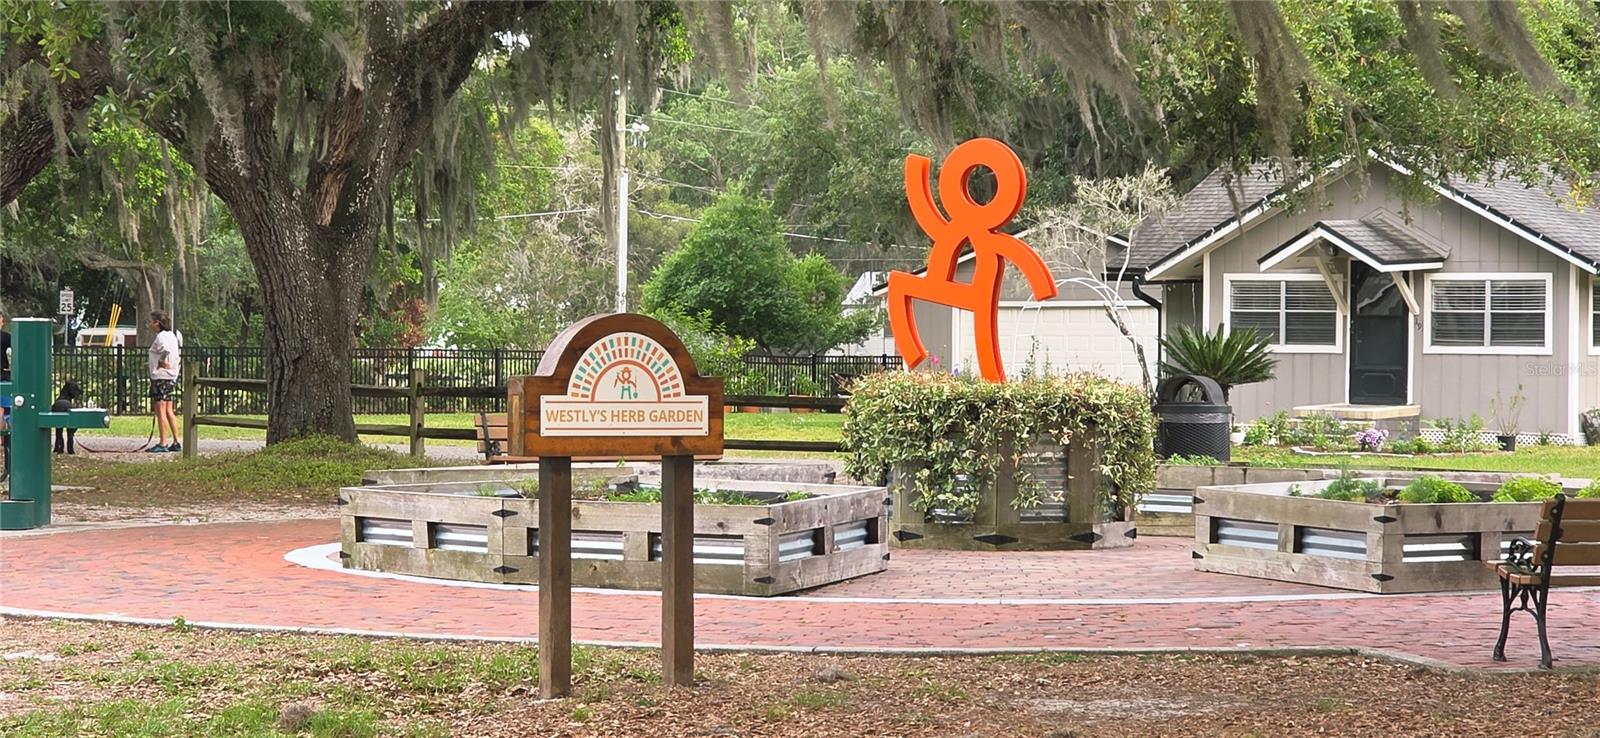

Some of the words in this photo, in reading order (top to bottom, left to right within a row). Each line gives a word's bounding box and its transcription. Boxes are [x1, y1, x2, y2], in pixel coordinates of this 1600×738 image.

[61, 303, 72, 312] 25
[545, 409, 607, 423] WESTLY'S
[611, 409, 645, 423] HERB
[649, 409, 703, 423] GARDEN
